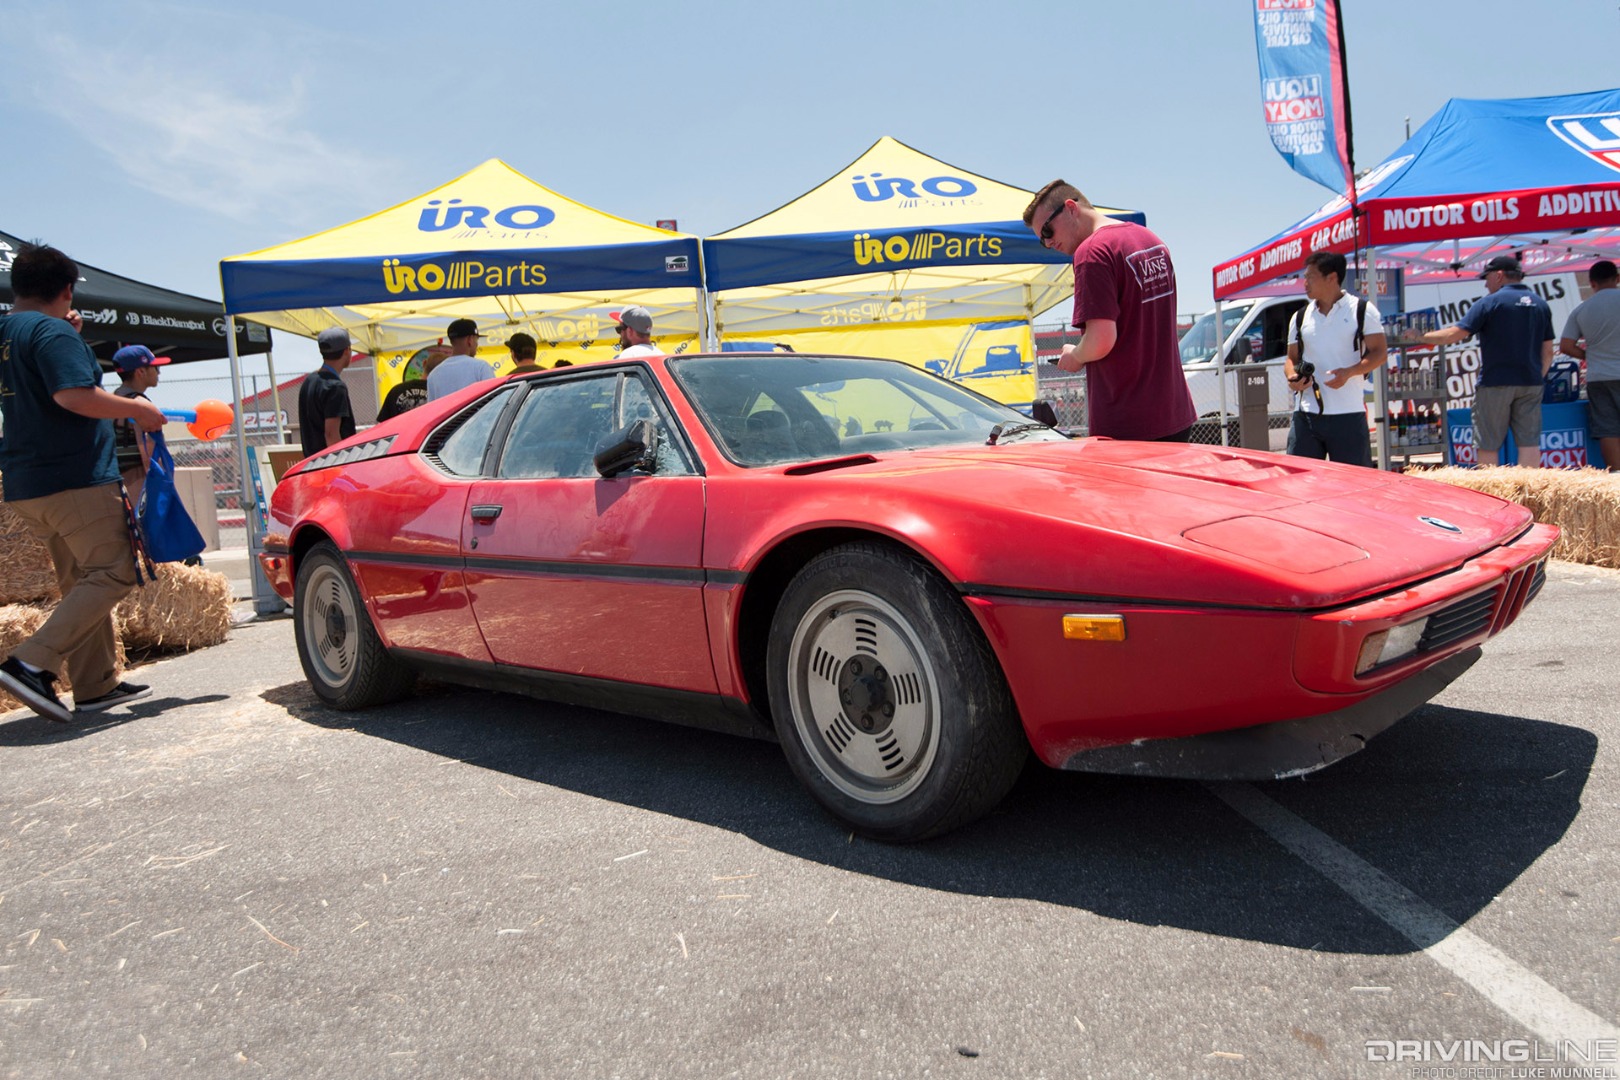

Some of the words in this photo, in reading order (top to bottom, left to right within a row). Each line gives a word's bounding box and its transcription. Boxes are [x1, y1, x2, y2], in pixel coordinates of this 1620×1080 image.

[852, 172, 978, 202] ÜRO
[417, 199, 556, 232] ÜRO
[1384, 203, 1465, 231] MOTOR
[1471, 197, 1520, 223] OILS
[853, 233, 911, 266] ÜRO
[928, 233, 1003, 258] Parts
[1216, 267, 1239, 289] MOTOR
[1238, 257, 1255, 280] OILS
[1259, 237, 1302, 272] ADDITIVES
[1310, 226, 1331, 252] CAR
[382, 258, 446, 294] ÜRO
[466, 261, 548, 288] Parts
[1139, 257, 1168, 277] VANS
[1534, 278, 1565, 302] ILS
[142, 314, 207, 330] BlackDiamond
